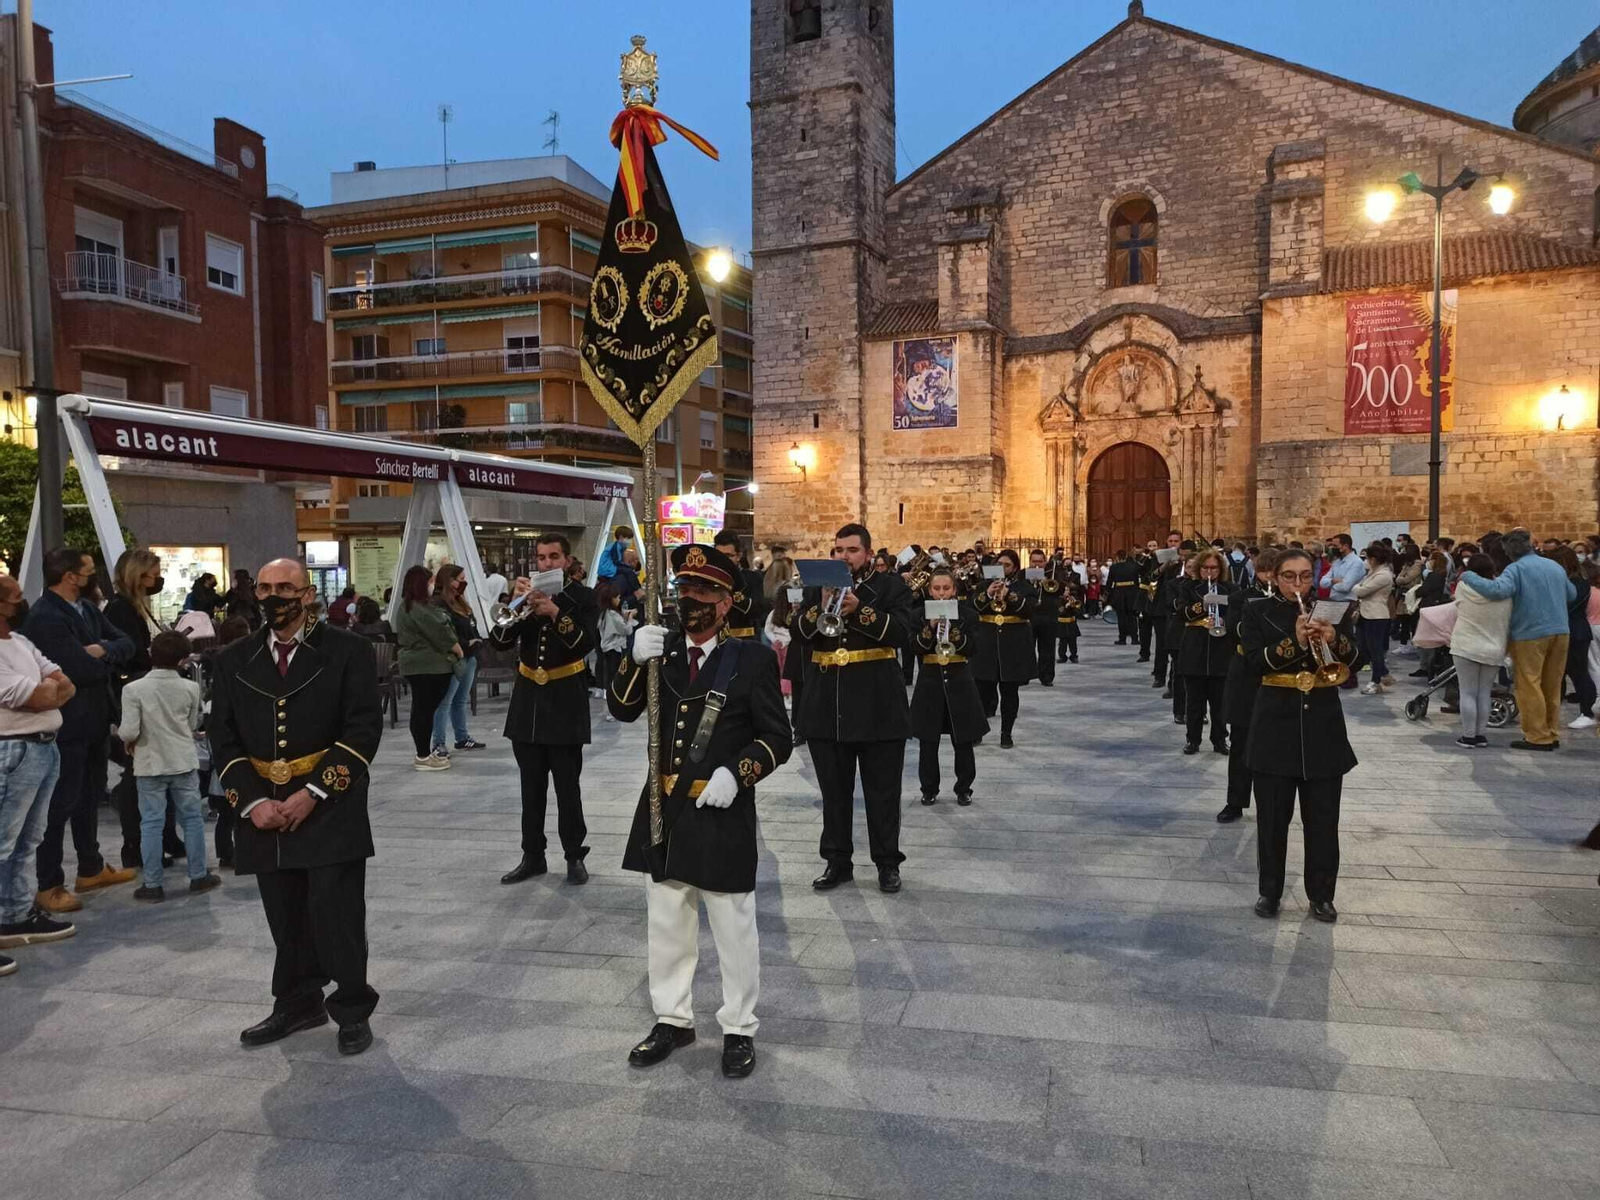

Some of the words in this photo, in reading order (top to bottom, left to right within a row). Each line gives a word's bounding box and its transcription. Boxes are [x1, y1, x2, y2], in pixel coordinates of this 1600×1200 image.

[1350, 299, 1405, 310] Archicofradía
[1357, 309, 1397, 318] Santísimo
[1353, 317, 1401, 326] Sacramento
[1370, 339, 1415, 348] aniversario
[1350, 341, 1413, 409] 500
[1385, 407, 1425, 417] Jubilar
[894, 415, 910, 428] 50
[115, 427, 219, 457] alacant
[375, 457, 410, 477] Sánchez
[412, 462, 439, 480] Bertelli
[469, 467, 516, 486] alacant
